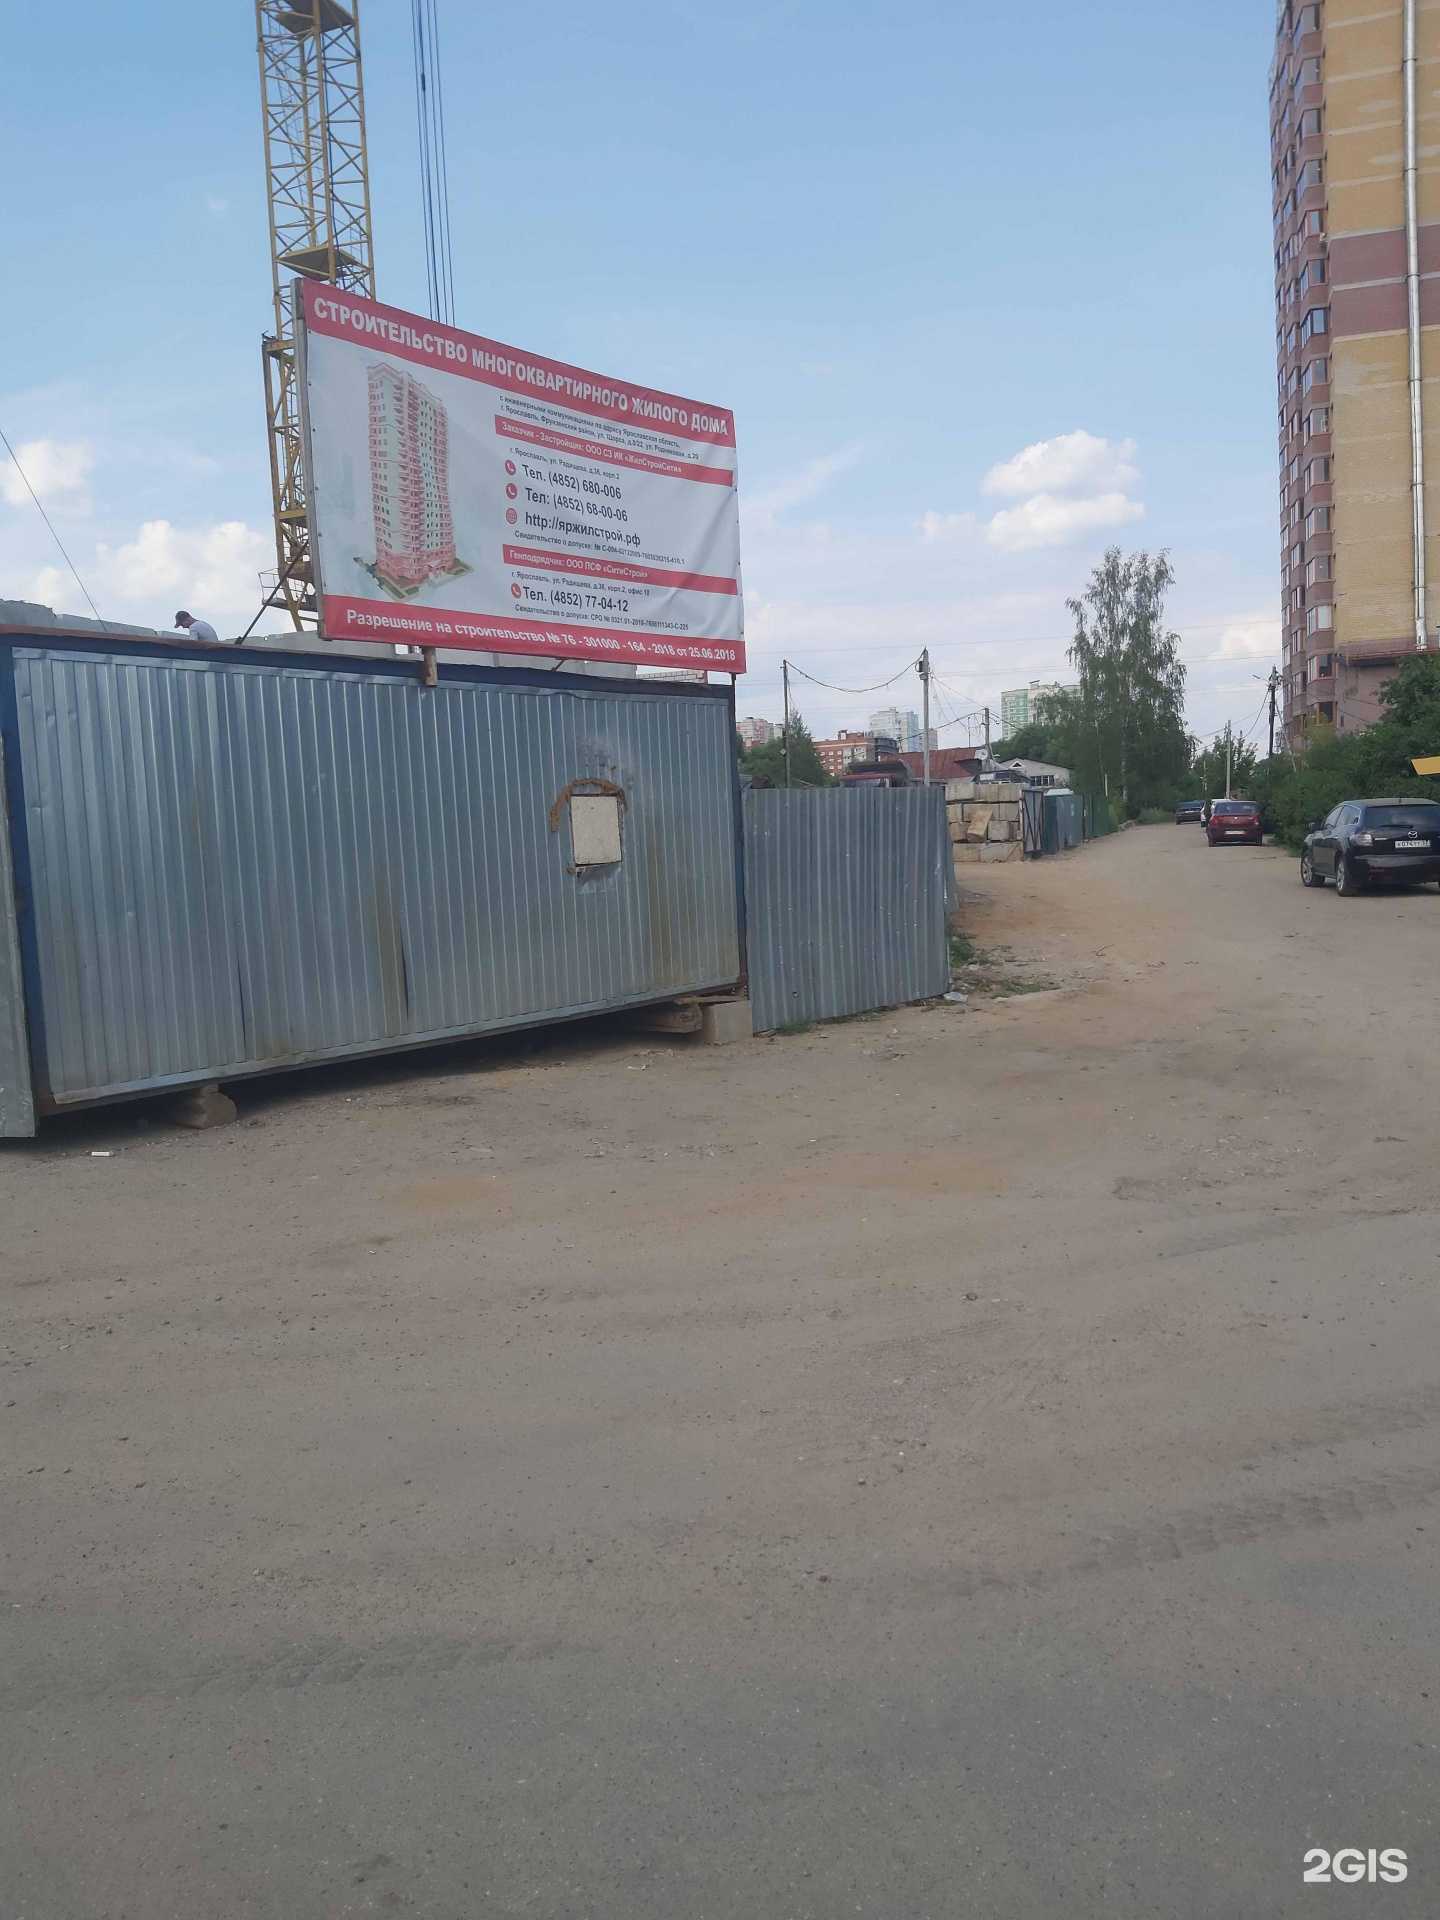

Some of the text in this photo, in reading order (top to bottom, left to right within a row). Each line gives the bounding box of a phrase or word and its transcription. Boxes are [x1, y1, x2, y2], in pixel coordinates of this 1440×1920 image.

[314, 297, 728, 436] СТРОИТЕЛЬСТВО МНОГОКВАРТИРНОГО ЖИЛОГО ДОМА
[585, 444, 601, 455] ООО
[521, 464, 621, 499] Тел. (4852) 680-006
[553, 493, 584, 515] (4852)
[586, 501, 627, 522] 68-00-06
[525, 511, 640, 548] http://яржилстрой.рф
[566, 558, 583, 569] ООО
[522, 586, 629, 612] Тел. (4852) 77-04-12
[346, 609, 432, 634] Разрешение
[435, 623, 451, 633] на
[454, 624, 546, 644] строительство
[547, 632, 561, 643] №
[561, 633, 576, 644] 76
[652, 642, 676, 655] 2018
[689, 645, 736, 661] 25.06.2018
